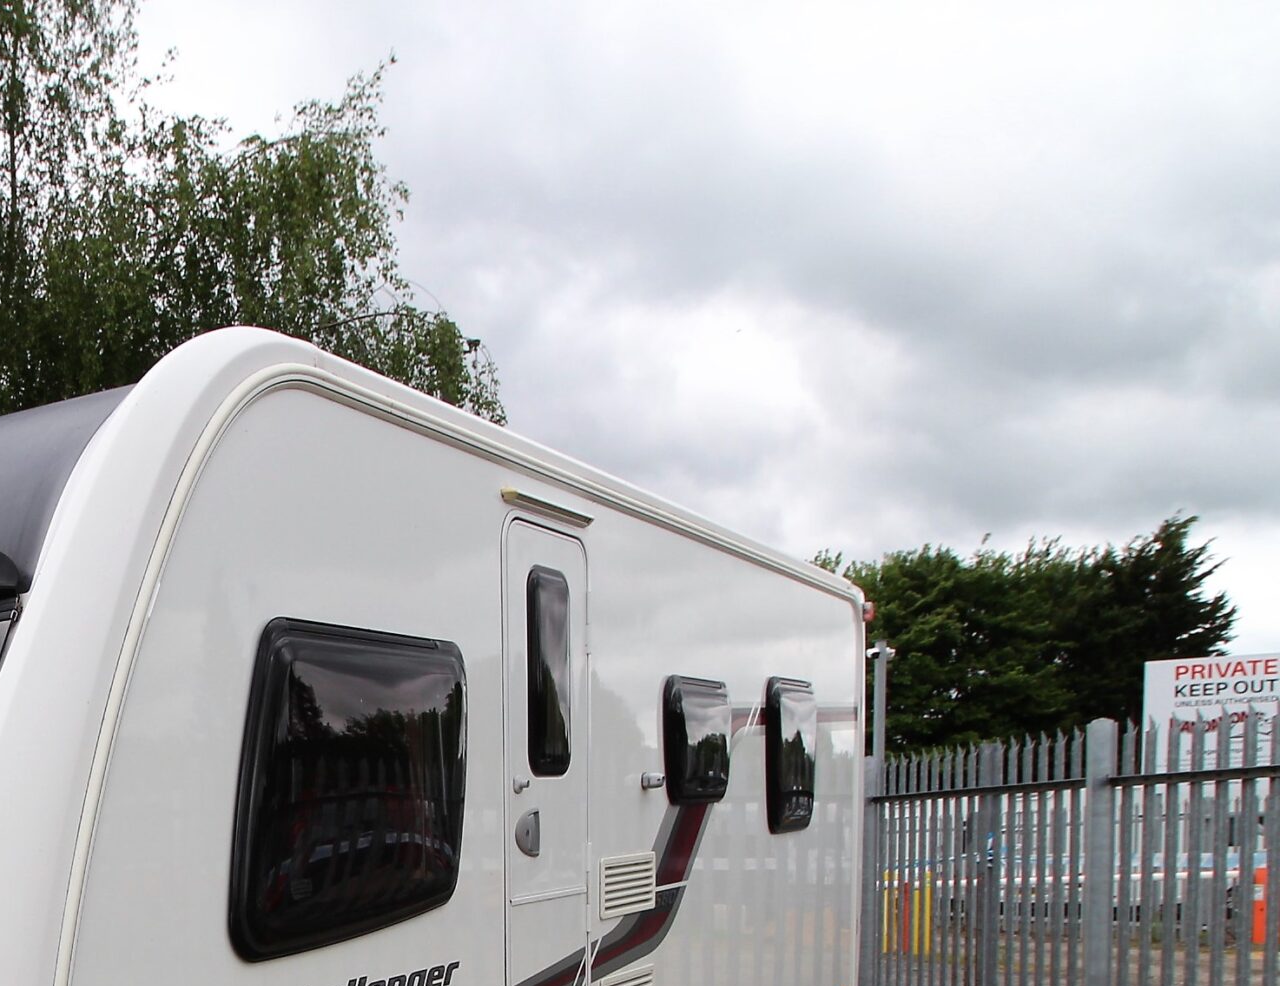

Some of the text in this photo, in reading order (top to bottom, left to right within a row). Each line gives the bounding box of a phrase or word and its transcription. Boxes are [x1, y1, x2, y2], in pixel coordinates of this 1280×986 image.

[1174, 659, 1278, 680] PRIVATE
[1174, 679, 1280, 698] KEEP OUT
[1174, 696, 1279, 708] UNLESS AUTHORISED
